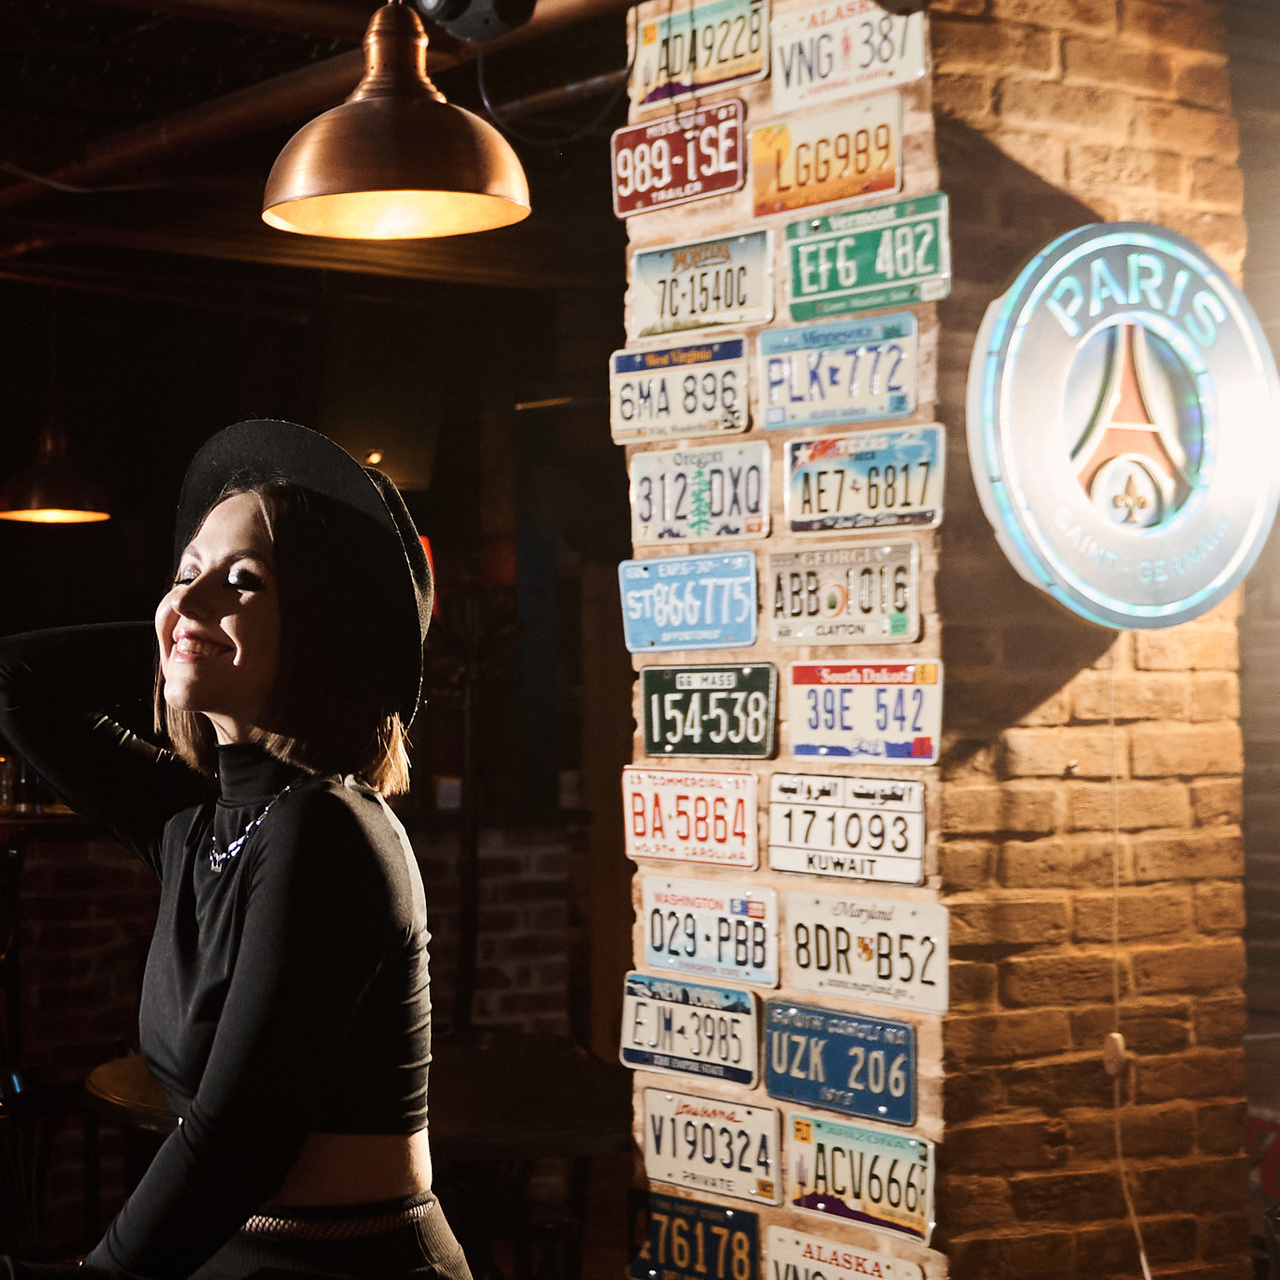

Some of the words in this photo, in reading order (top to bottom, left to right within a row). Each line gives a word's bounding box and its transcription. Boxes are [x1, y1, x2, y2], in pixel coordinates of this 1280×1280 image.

[779, 33, 833, 88] VNG
[775, 124, 890, 192] LGG989
[798, 237, 858, 294] EFG
[875, 222, 935, 280] 482
[1045, 253, 1227, 348] PARIS
[620, 378, 670, 421] 6MA
[683, 370, 736, 414] 896
[639, 472, 688, 522] 312
[710, 465, 761, 518] DXQ
[867, 461, 931, 510] 6817
[820, 667, 862, 684] South
[651, 691, 767, 744] 154-538
[807, 688, 853, 731] 39E
[876, 688, 923, 732] 542
[784, 809, 909, 853] 171093
[806, 854, 878, 876] KUWAIT
[653, 892, 724, 911] WASHINGTON
[832, 901, 895, 924] Maryland
[877, 932, 937, 986] B52
[772, 1031, 828, 1083] UZK
[848, 1046, 908, 1098] 206
[651, 1114, 771, 1176] V190324
[814, 1142, 918, 1212] ACV666
[802, 1243, 884, 1278] ALASKA
